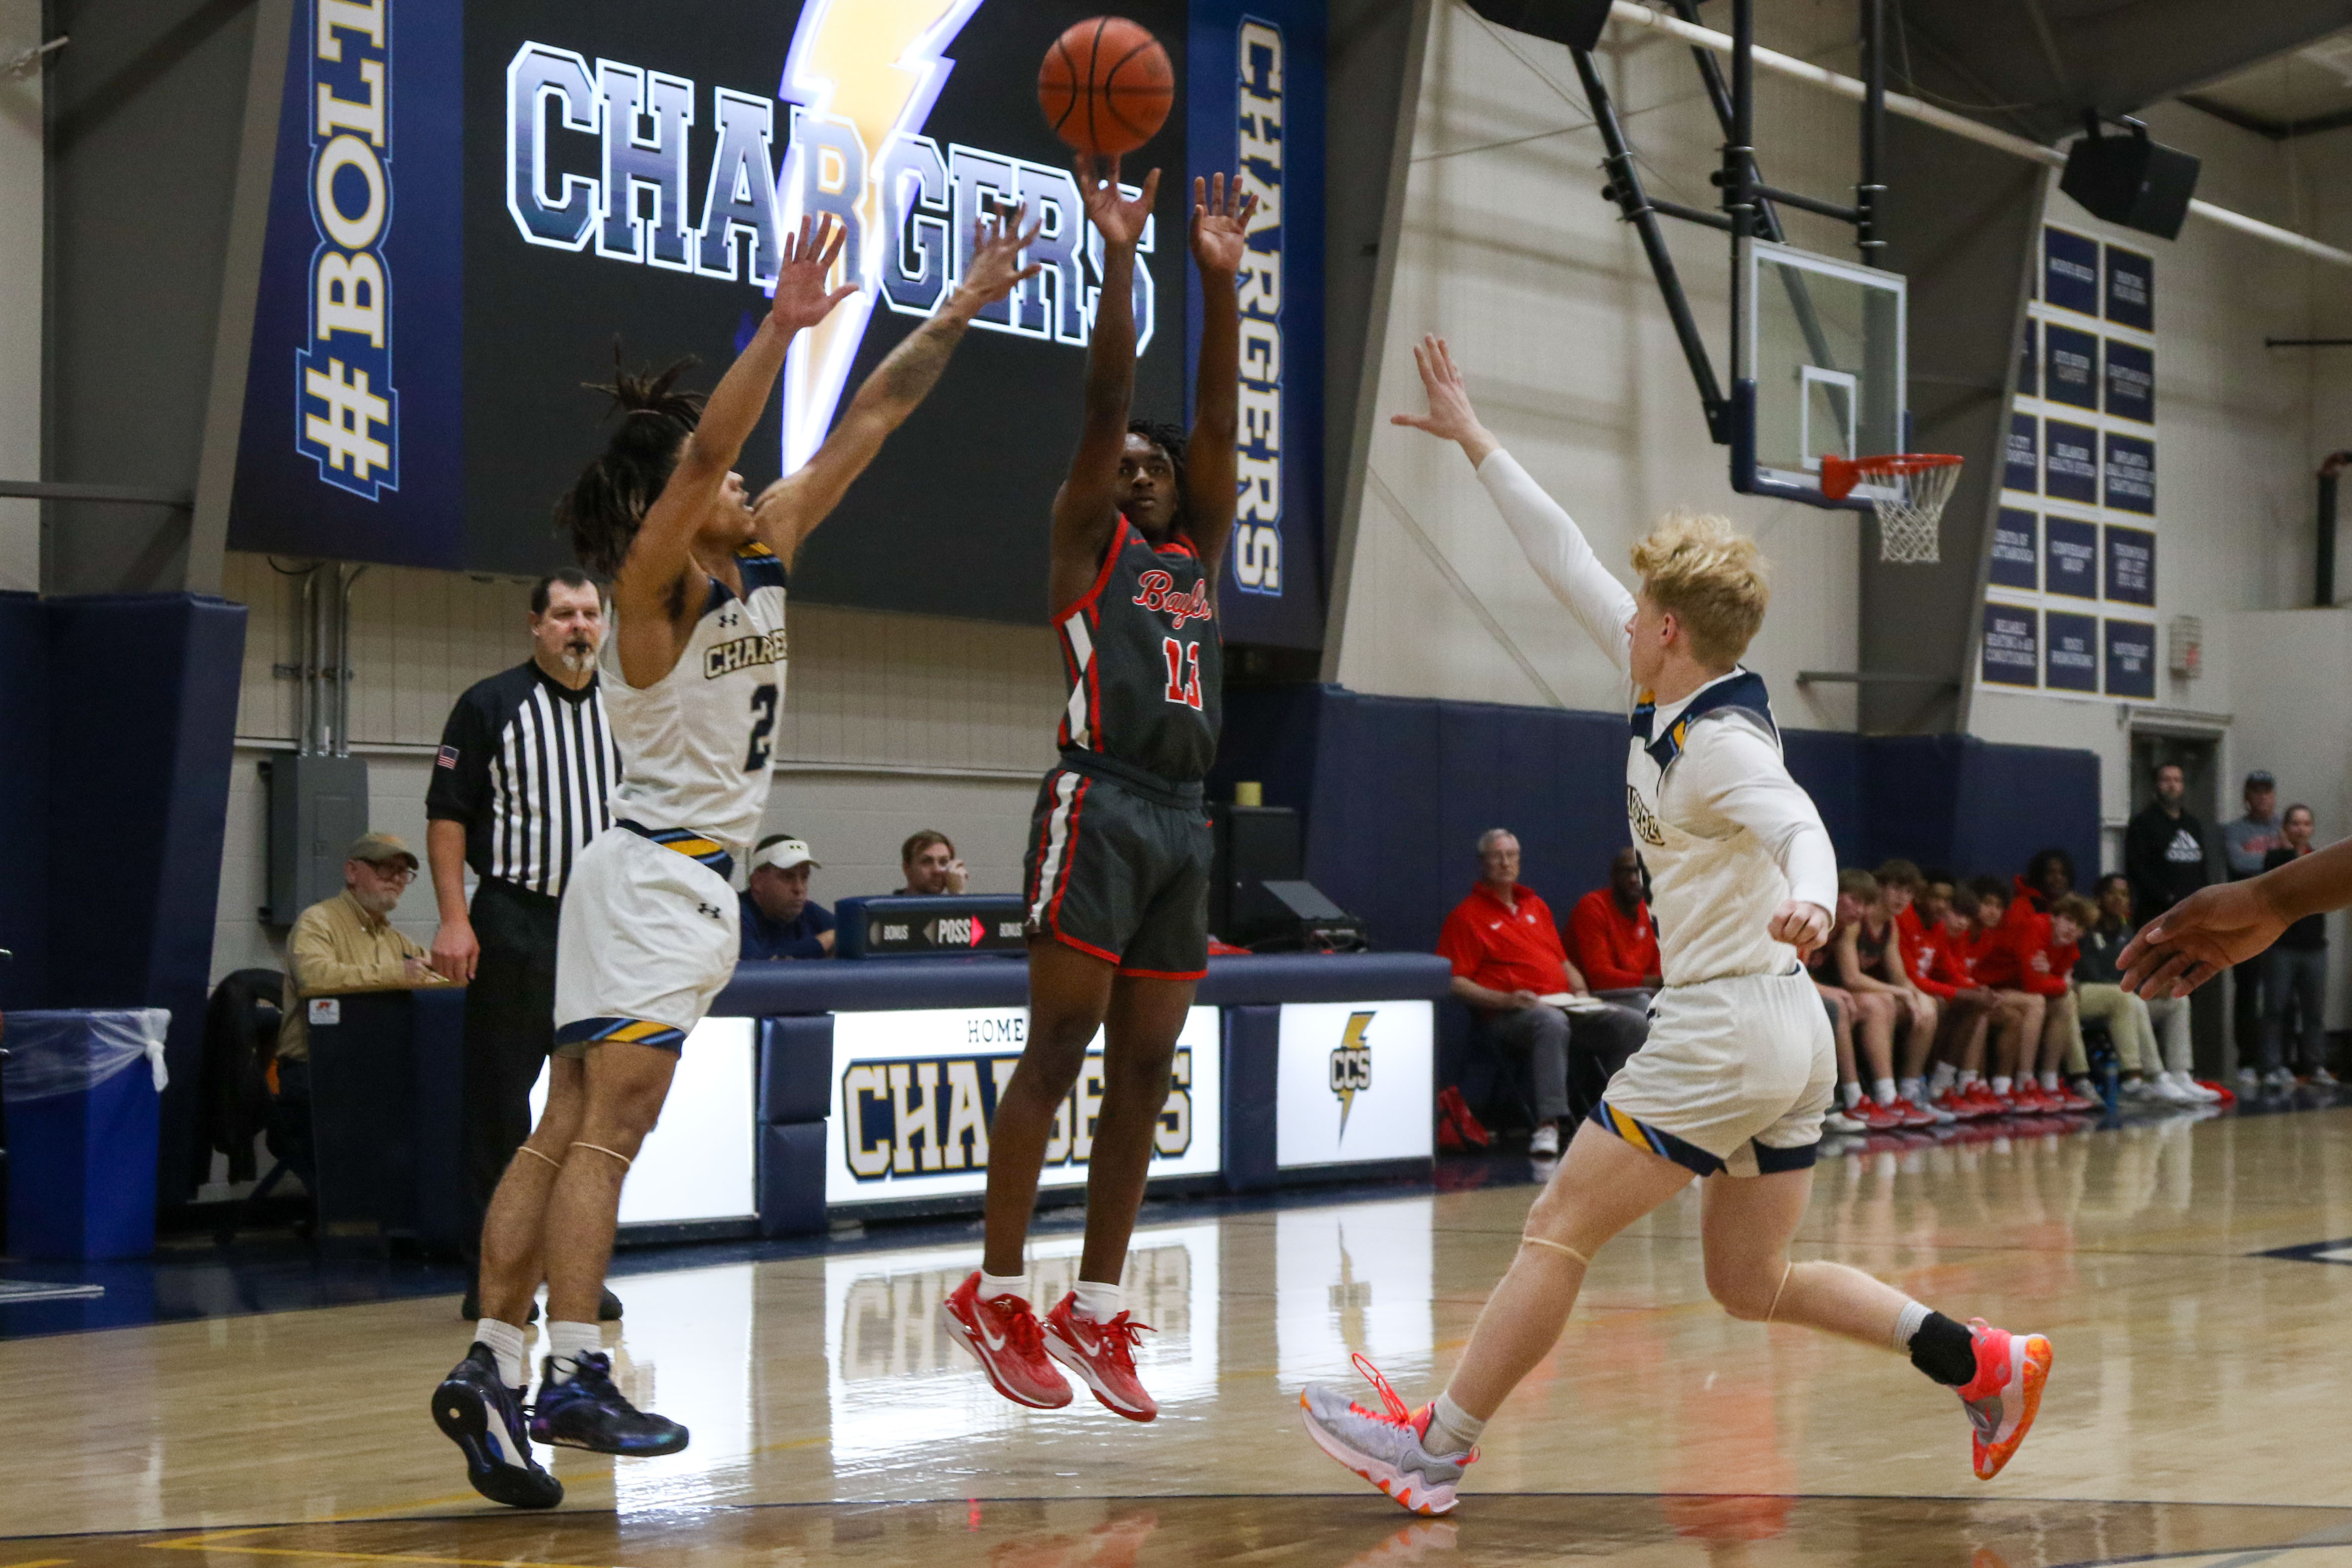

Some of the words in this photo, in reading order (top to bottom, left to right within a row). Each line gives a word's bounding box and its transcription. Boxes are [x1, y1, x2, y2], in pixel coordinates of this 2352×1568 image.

[1236, 22, 1283, 588] CHARGERS
[744, 683, 779, 772] 2
[884, 924, 909, 940] BONUS
[938, 919, 971, 944] POSS
[999, 922, 1023, 938] BONUS
[968, 1018, 1024, 1043] HOME
[1330, 1046, 1372, 1093] CCS
[842, 1045, 1193, 1182] CHAES
